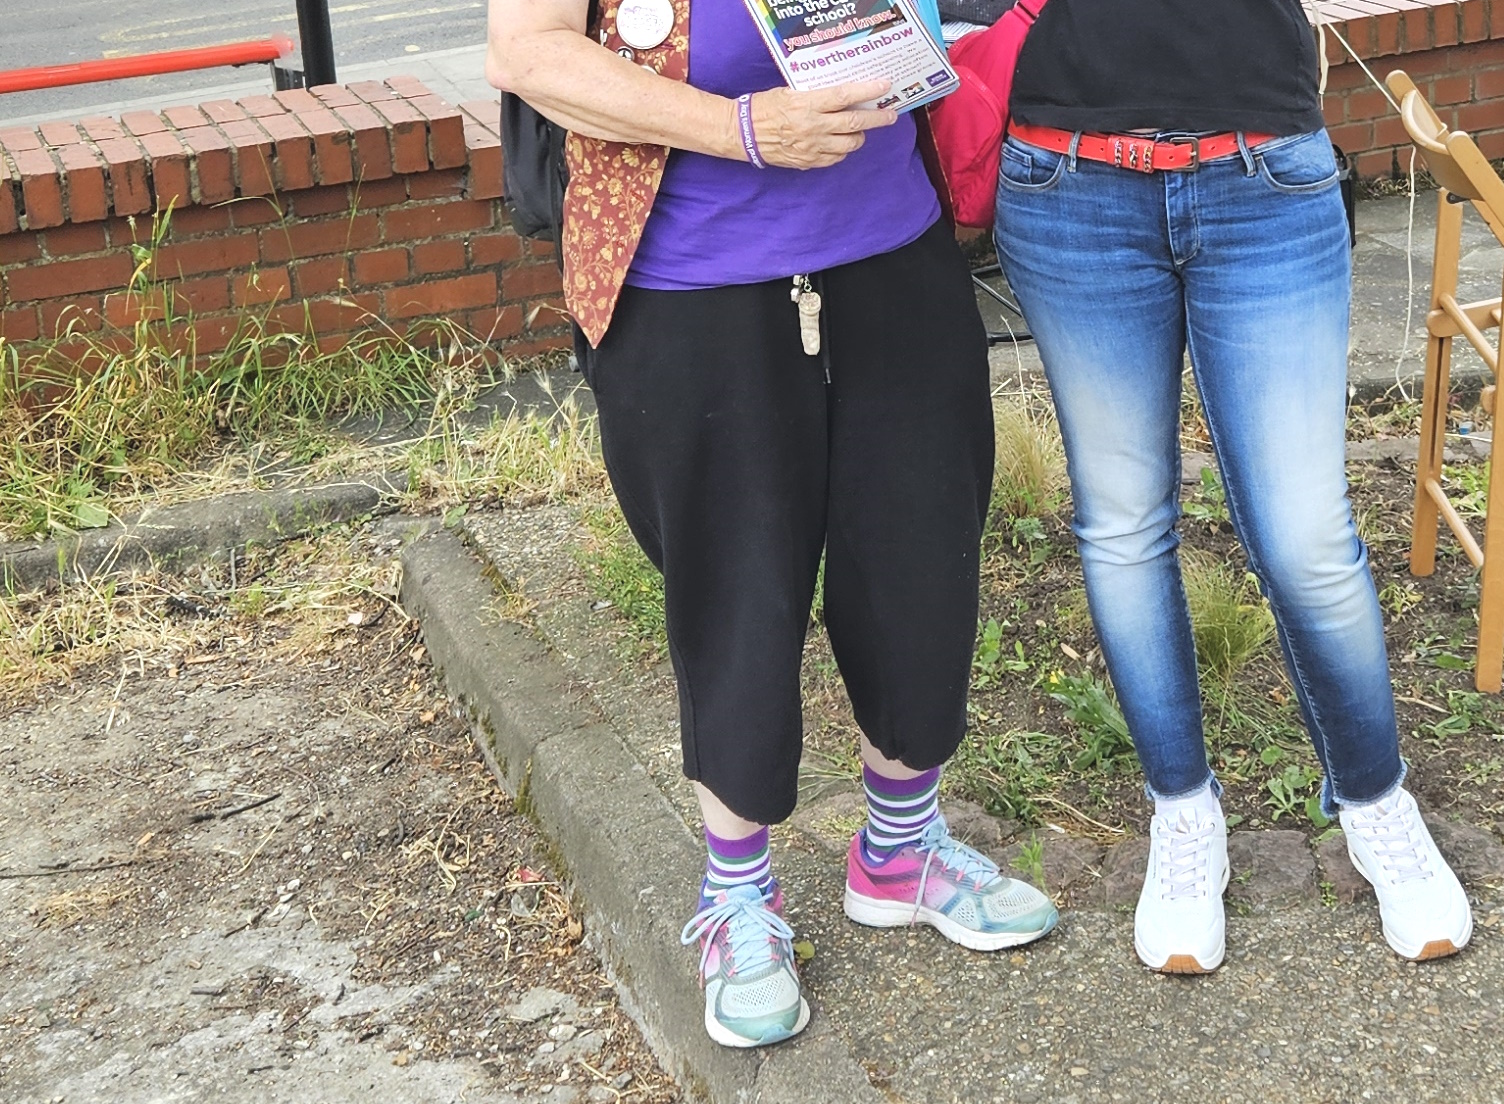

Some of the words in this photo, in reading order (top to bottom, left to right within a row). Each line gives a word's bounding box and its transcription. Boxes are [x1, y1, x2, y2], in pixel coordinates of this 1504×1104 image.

[773, 5, 804, 19] into
[804, 3, 857, 27] school?
[783, 34, 811, 52] you
[810, 20, 855, 43] should
[853, 9, 896, 30] know.
[789, 26, 913, 73] #overtherainbow
[740, 104, 749, 118] Day
